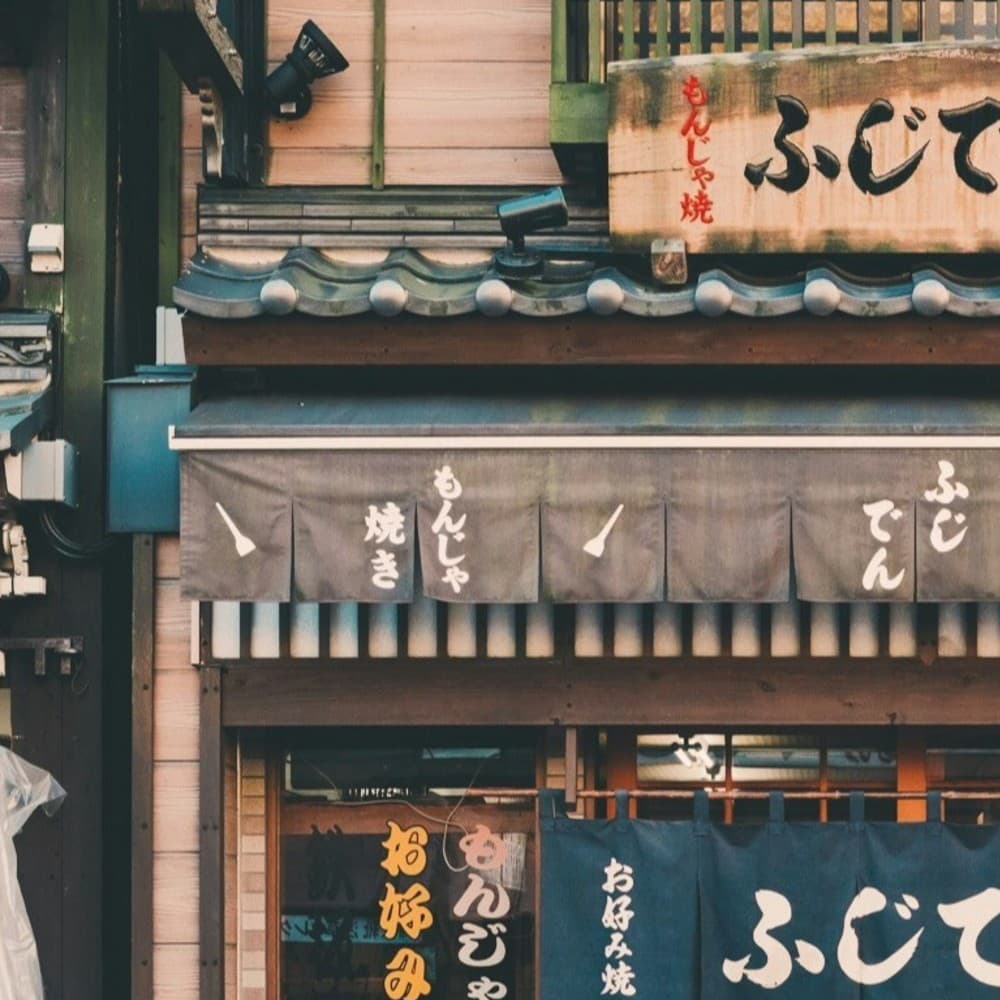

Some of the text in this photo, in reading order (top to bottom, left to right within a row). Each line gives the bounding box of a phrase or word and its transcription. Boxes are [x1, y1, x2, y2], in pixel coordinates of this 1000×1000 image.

[679, 74, 715, 224] もんじゃ焼
[364, 502, 406, 590] 焼き
[431, 465, 470, 594] もんじゃ
[862, 500, 906, 591] でん
[924, 461, 969, 553] ふじ
[601, 857, 637, 998] お好み焼
